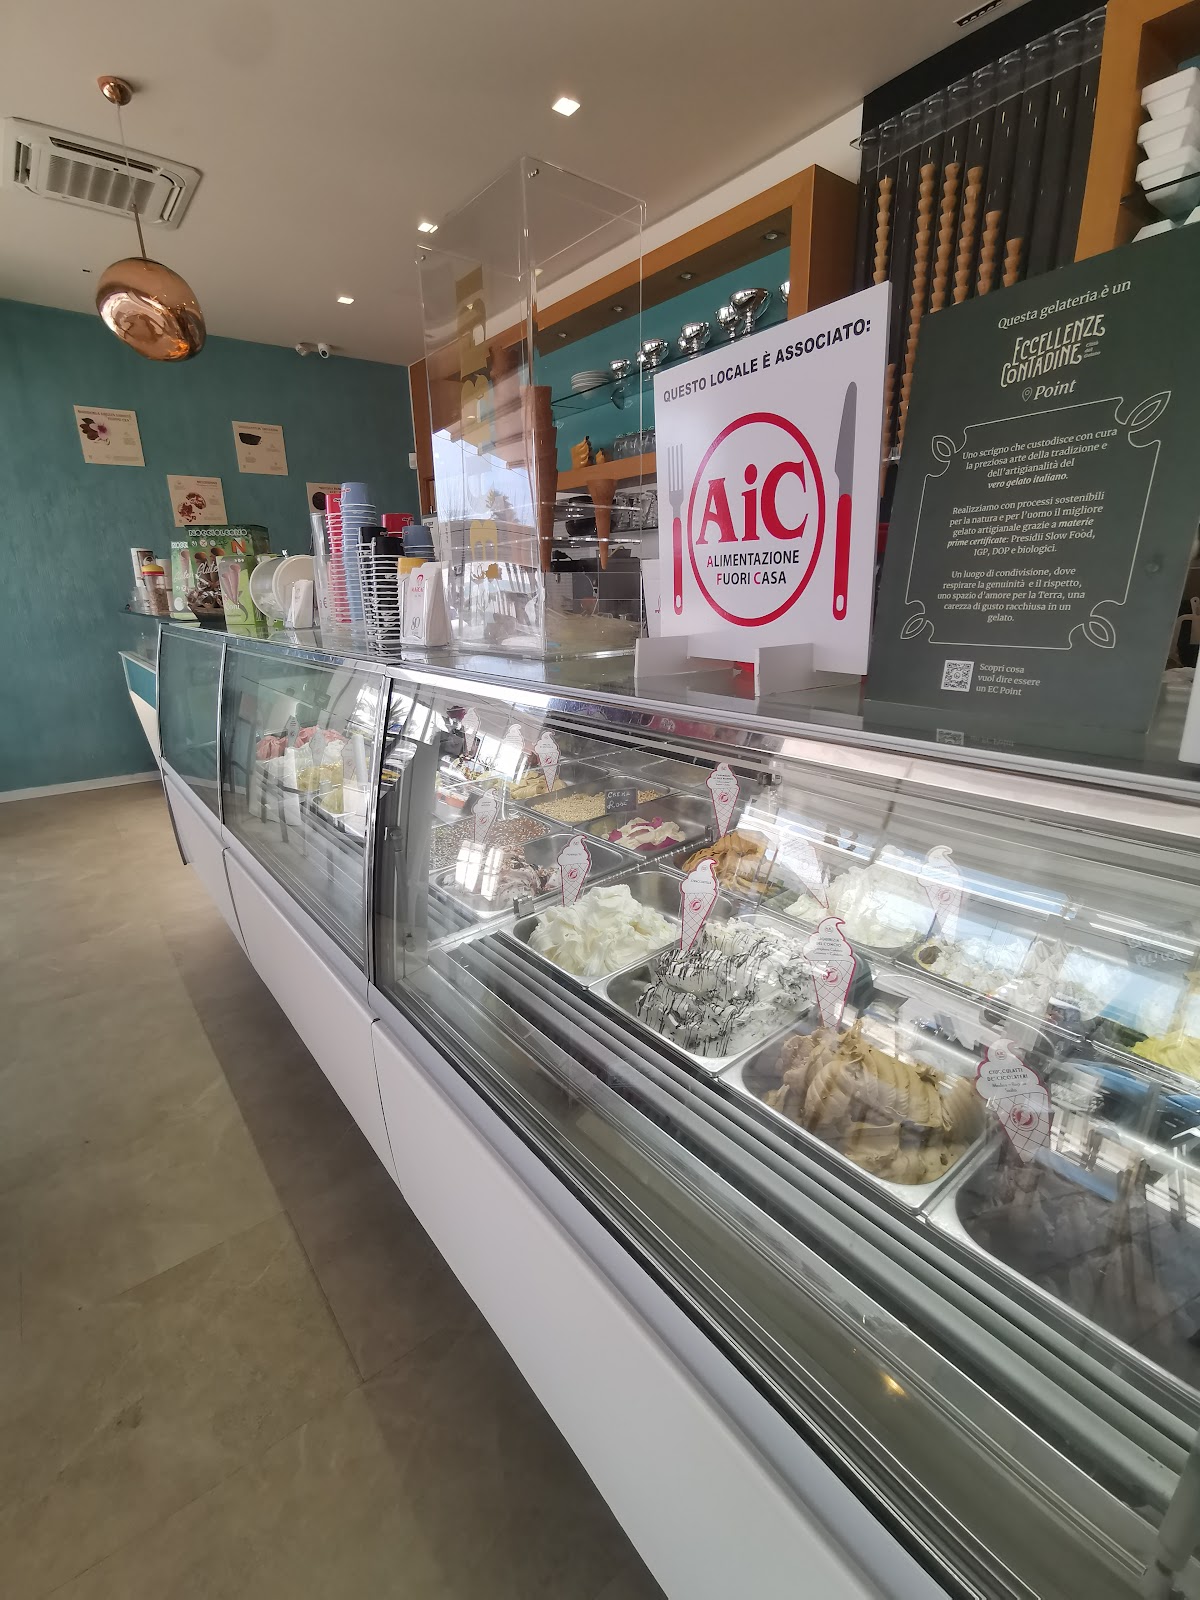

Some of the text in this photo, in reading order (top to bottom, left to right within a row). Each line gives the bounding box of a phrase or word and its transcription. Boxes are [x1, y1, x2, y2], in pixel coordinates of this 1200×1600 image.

[998, 280, 1131, 329] Questa gelateria è un
[1012, 314, 1106, 366] ECCELLENZE
[664, 318, 872, 402] QUESTO LOCALE È ASSOCIATO:
[1000, 343, 1082, 388] CONTADINE
[1034, 379, 1076, 400] Point
[963, 428, 1118, 460] Uno scrigno che custodisce con cura
[966, 442, 1108, 471] la preziosa arte della tradizione e
[1060, 458, 1075, 468] del
[988, 472, 1068, 489] vero gelato italiano.
[696, 460, 808, 545] AiC
[952, 491, 1105, 514] Realizziamo con processi sostenibili
[950, 517, 962, 527] per
[963, 515, 970, 524] la
[972, 514, 998, 524] natura
[998, 514, 1004, 522] e
[1005, 512, 1020, 522] per
[1054, 508, 1060, 517] il
[1062, 504, 1104, 516] migliore
[952, 517, 1094, 538] gelato artigianale grazie a materie
[947, 538, 968, 548] prime
[970, 536, 1009, 546] certificate:
[1045, 530, 1068, 540] Slow
[1069, 529, 1096, 540] Food,
[706, 550, 800, 568] ALIMENTAZIONE
[974, 548, 990, 557] IGP,
[992, 547, 1010, 555] DOP
[1017, 544, 1056, 556] biologici.
[197, 561, 220, 576] Glute
[952, 567, 1076, 580] Un luogo di condivisione, dove
[716, 571, 786, 586] FUORI CASA
[943, 581, 976, 590] respirare
[986, 580, 1025, 590] genuinità
[1036, 580, 1042, 588] il
[1044, 580, 1082, 589] rispetto,
[938, 592, 952, 600] uno
[952, 592, 976, 601] spazio
[978, 590, 1012, 599] d'amore
[1012, 592, 1026, 600] per
[1028, 590, 1036, 598] la
[1038, 591, 1065, 600] Terra,
[944, 602, 972, 610] carezza
[973, 602, 980, 610] di
[982, 603, 1004, 612] gusto
[1006, 602, 1046, 611] racchiusa
[1048, 602, 1057, 610] in
[987, 613, 1014, 623] gelato.
[980, 664, 1024, 674] Scopri cosa
[996, 676, 1012, 684] dire
[1014, 678, 1040, 686] essere
[1000, 686, 1022, 696] Point
